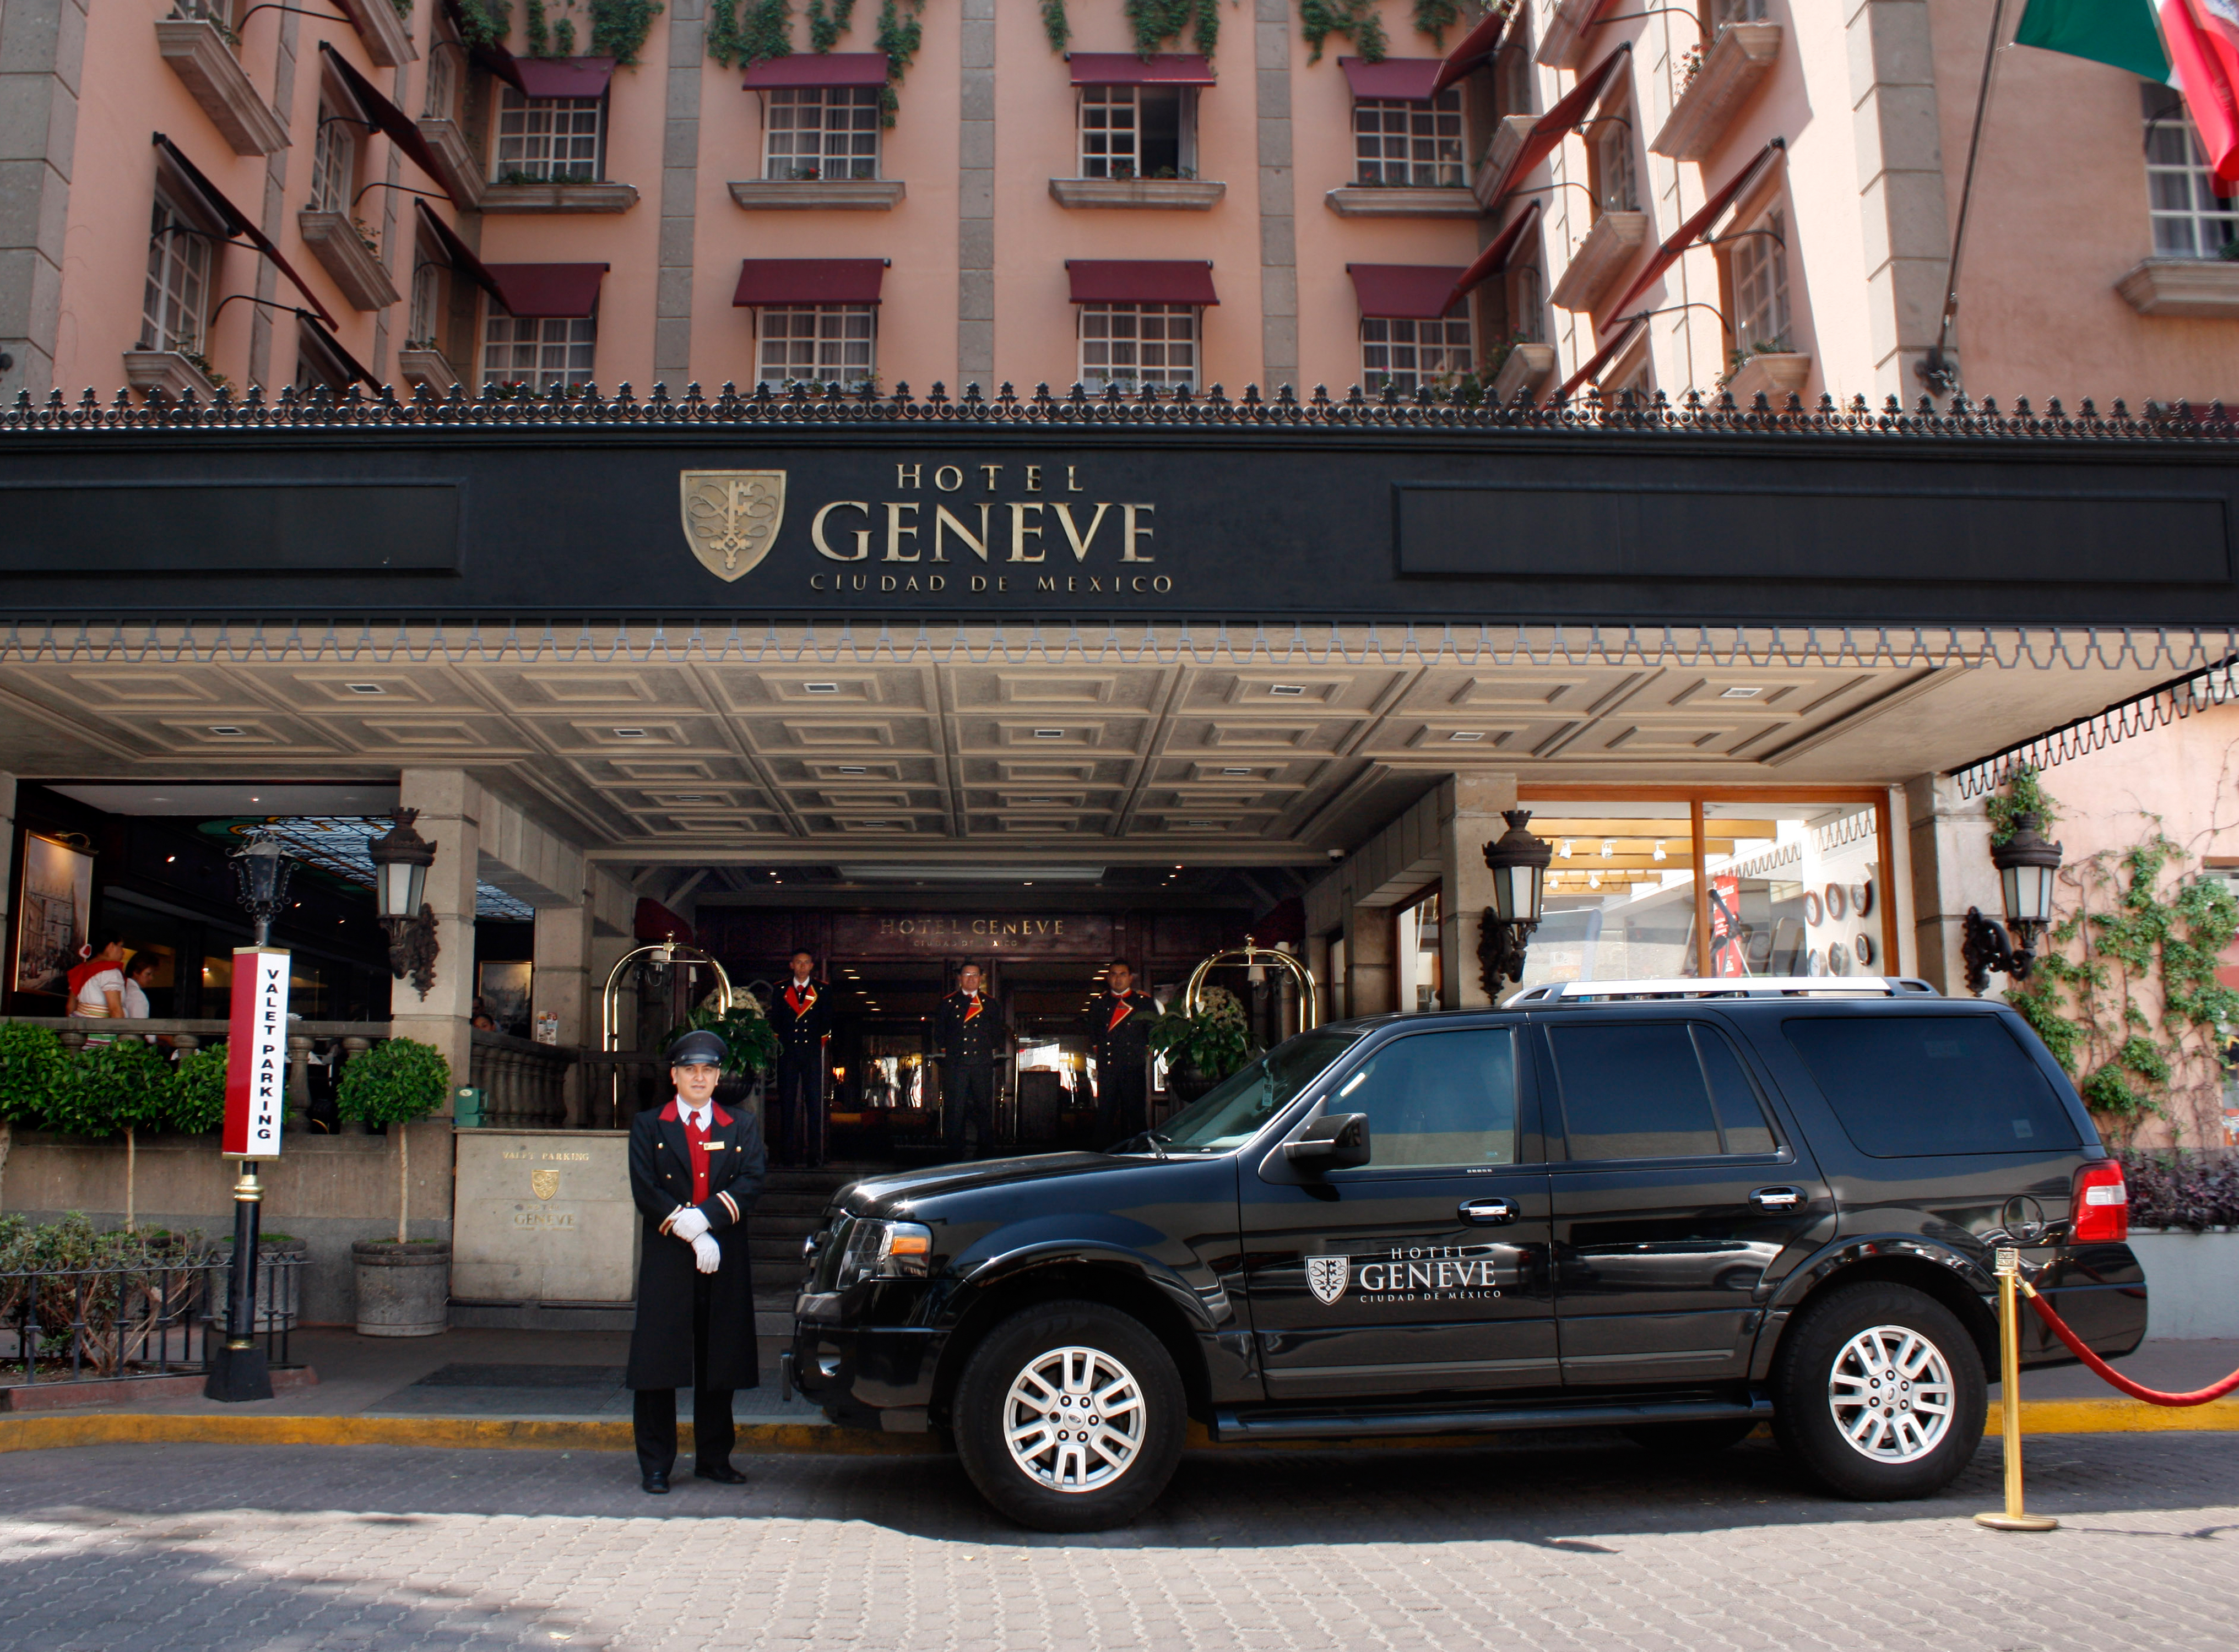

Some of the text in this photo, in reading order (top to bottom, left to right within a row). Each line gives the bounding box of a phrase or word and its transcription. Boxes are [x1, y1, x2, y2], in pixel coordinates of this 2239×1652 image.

[897, 464, 1083, 491] HOTEL
[811, 501, 1155, 563] GENEVE
[810, 574, 1173, 594] CIUDAD DE MEXICO
[880, 920, 1064, 935] HOTEL GENEVE
[257, 969, 279, 1139] VALET PARKING
[542, 1151, 589, 1161] PARKING
[514, 1213, 574, 1225] GENEVE
[1391, 1246, 1466, 1259] HOTEL
[1359, 1260, 1496, 1291] GENEVE
[1360, 1292, 1414, 1303] CIUDAD
[1448, 1290, 1501, 1300] MÉXICO
